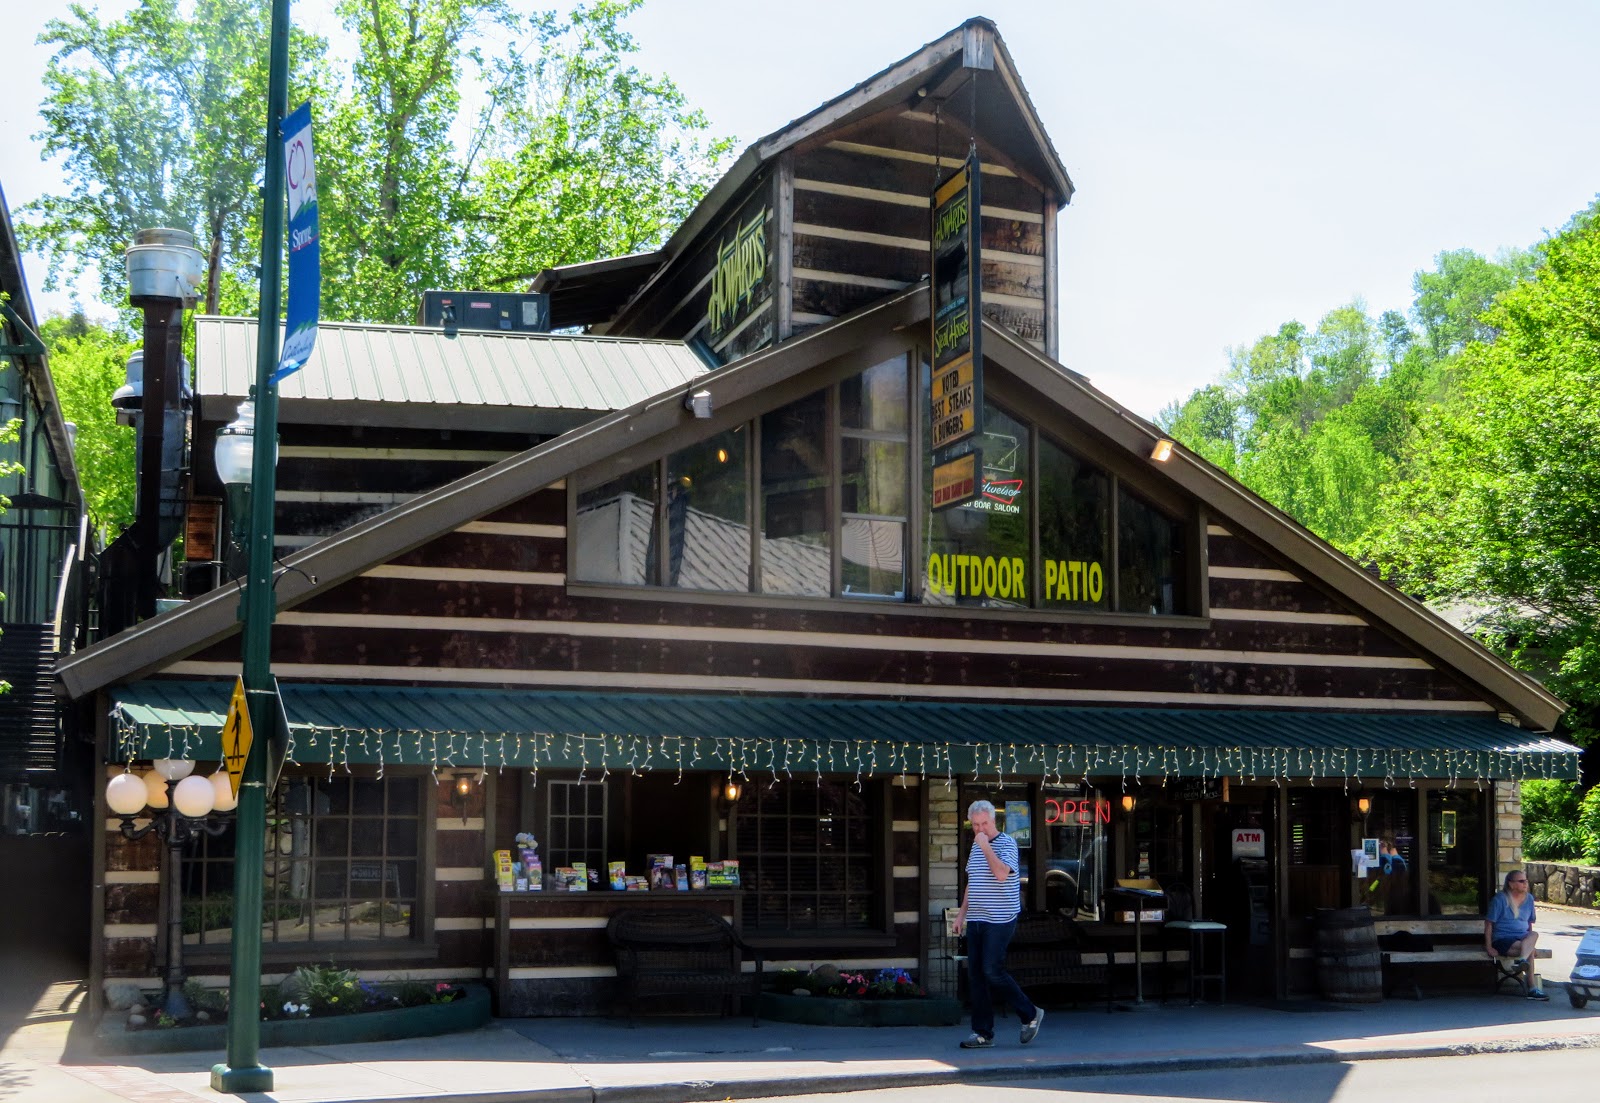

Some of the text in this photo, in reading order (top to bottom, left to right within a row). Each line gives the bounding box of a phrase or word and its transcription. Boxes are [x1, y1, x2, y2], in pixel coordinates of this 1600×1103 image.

[935, 195, 968, 250] HOWARDS
[292, 225, 312, 251] Spring
[708, 204, 766, 336] HOWARDS
[942, 370, 959, 394] VOTED
[949, 385, 972, 414] STEAKS
[939, 413, 964, 442] BURGERS
[982, 482, 1021, 497] dweiser
[974, 501, 992, 510] BOAR
[994, 503, 1020, 514] SALOON
[928, 552, 1103, 603] OUTDOOR PATIO
[1045, 799, 1111, 824] OPEN
[1236, 833, 1261, 843] ATM
